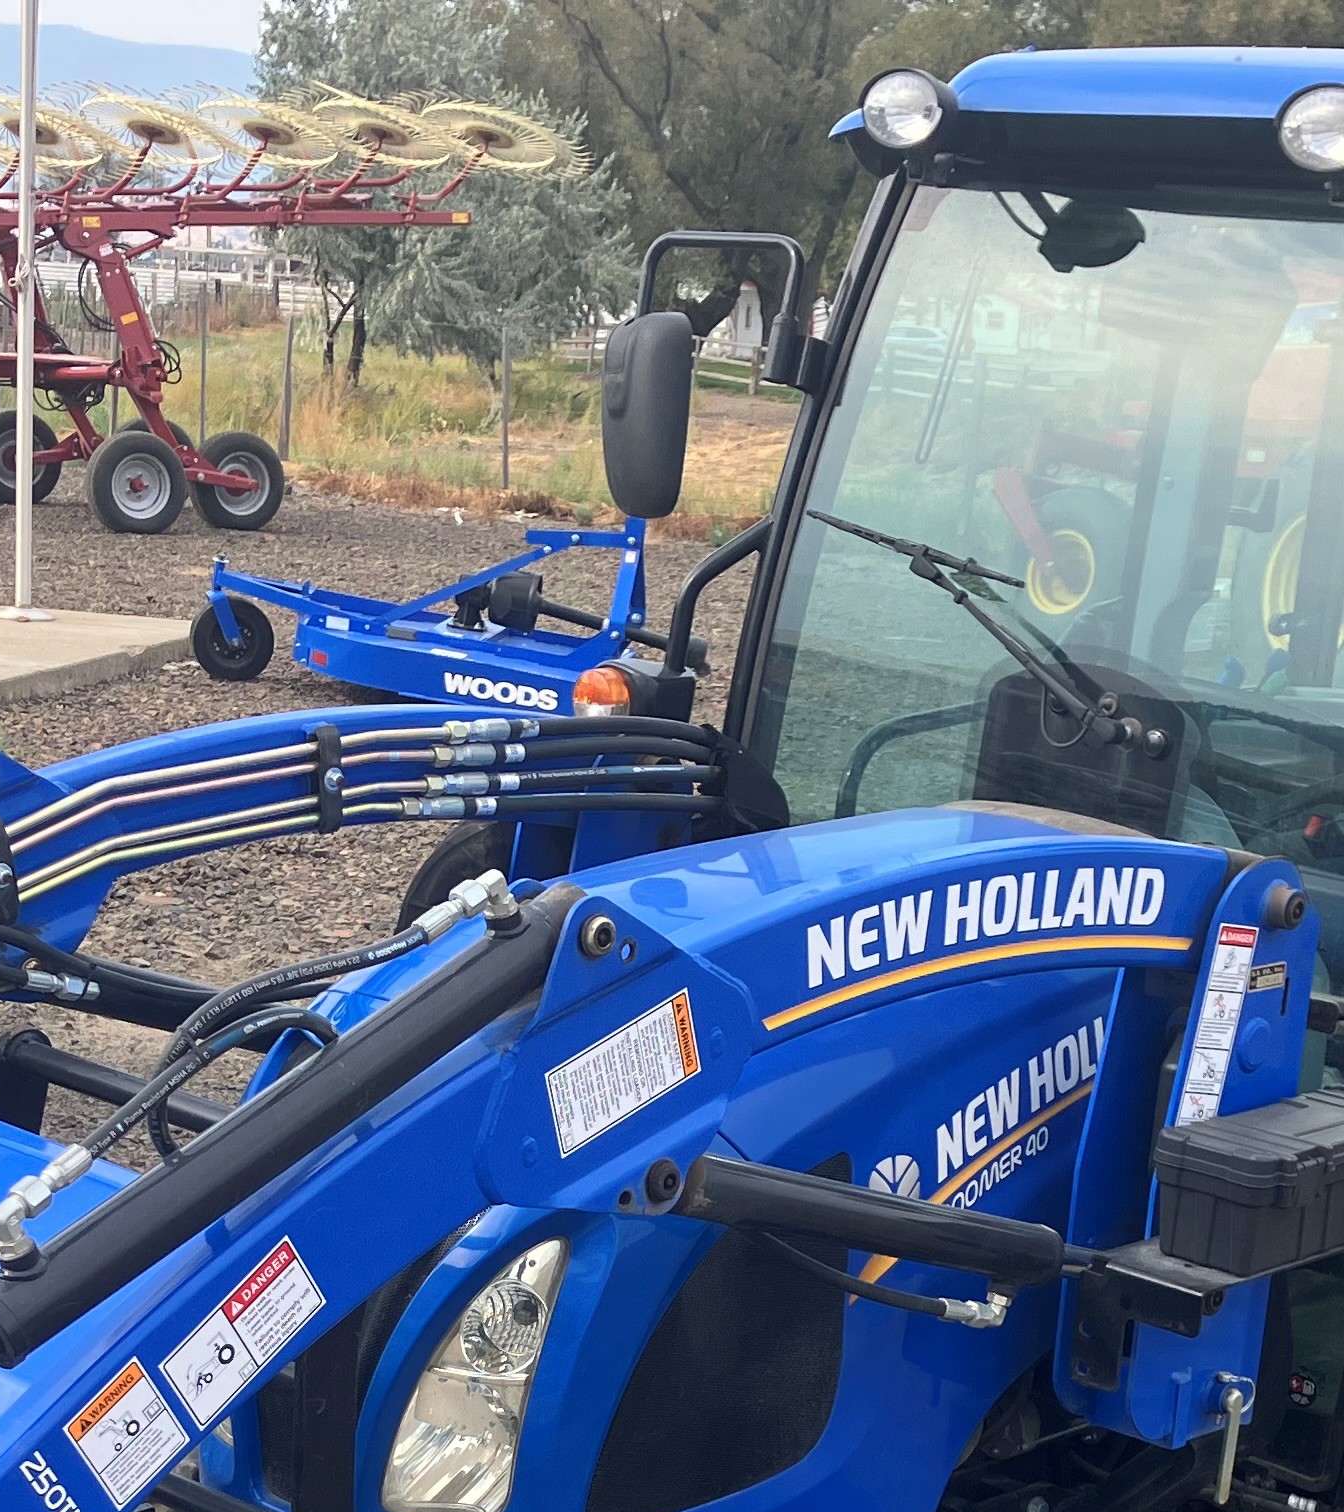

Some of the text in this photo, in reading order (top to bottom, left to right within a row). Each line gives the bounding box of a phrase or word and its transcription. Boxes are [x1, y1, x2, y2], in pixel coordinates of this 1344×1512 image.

[444, 672, 558, 711] WOODS
[807, 867, 1165, 989] NEW HOLLAND
[680, 1018, 693, 1067] WARNING
[168, 1070, 188, 1087] MSHA
[937, 1016, 1105, 1184] NEW HOLL
[947, 1126, 1049, 1211] OOMER 40
[241, 1251, 289, 1301] DANGER
[89, 1373, 135, 1419] WARNING
